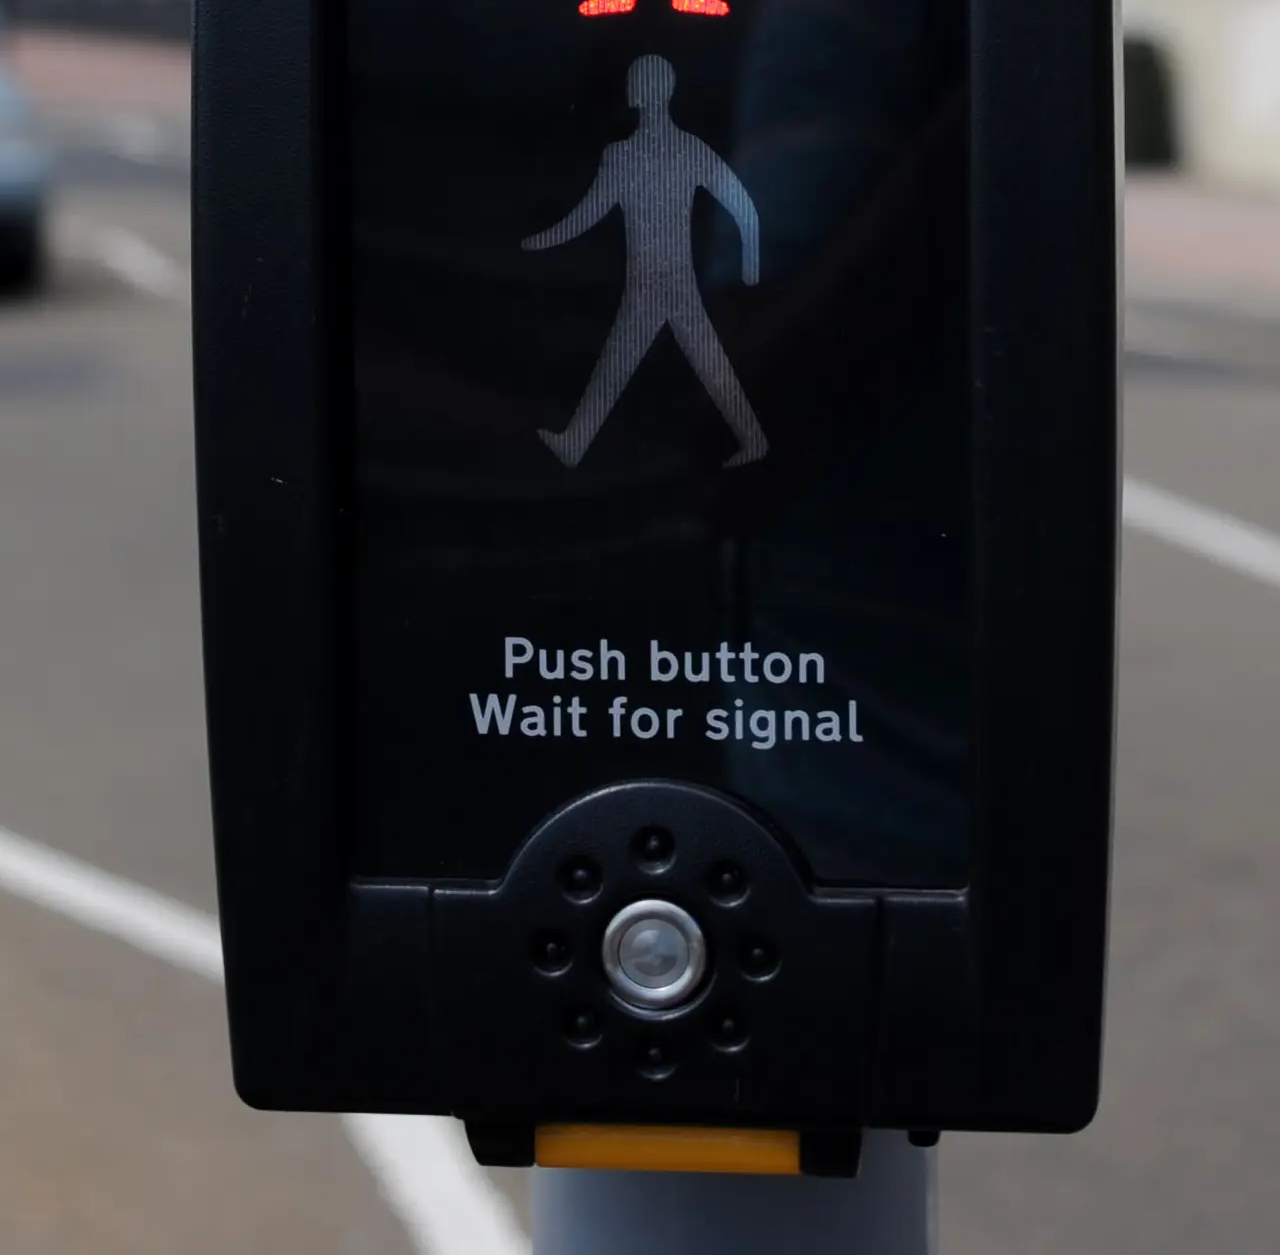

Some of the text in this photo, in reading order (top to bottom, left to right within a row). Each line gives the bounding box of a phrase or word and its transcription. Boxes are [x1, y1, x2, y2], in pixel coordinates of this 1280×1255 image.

[503, 635, 826, 685] Push button
[468, 692, 865, 751] Wait for signal
